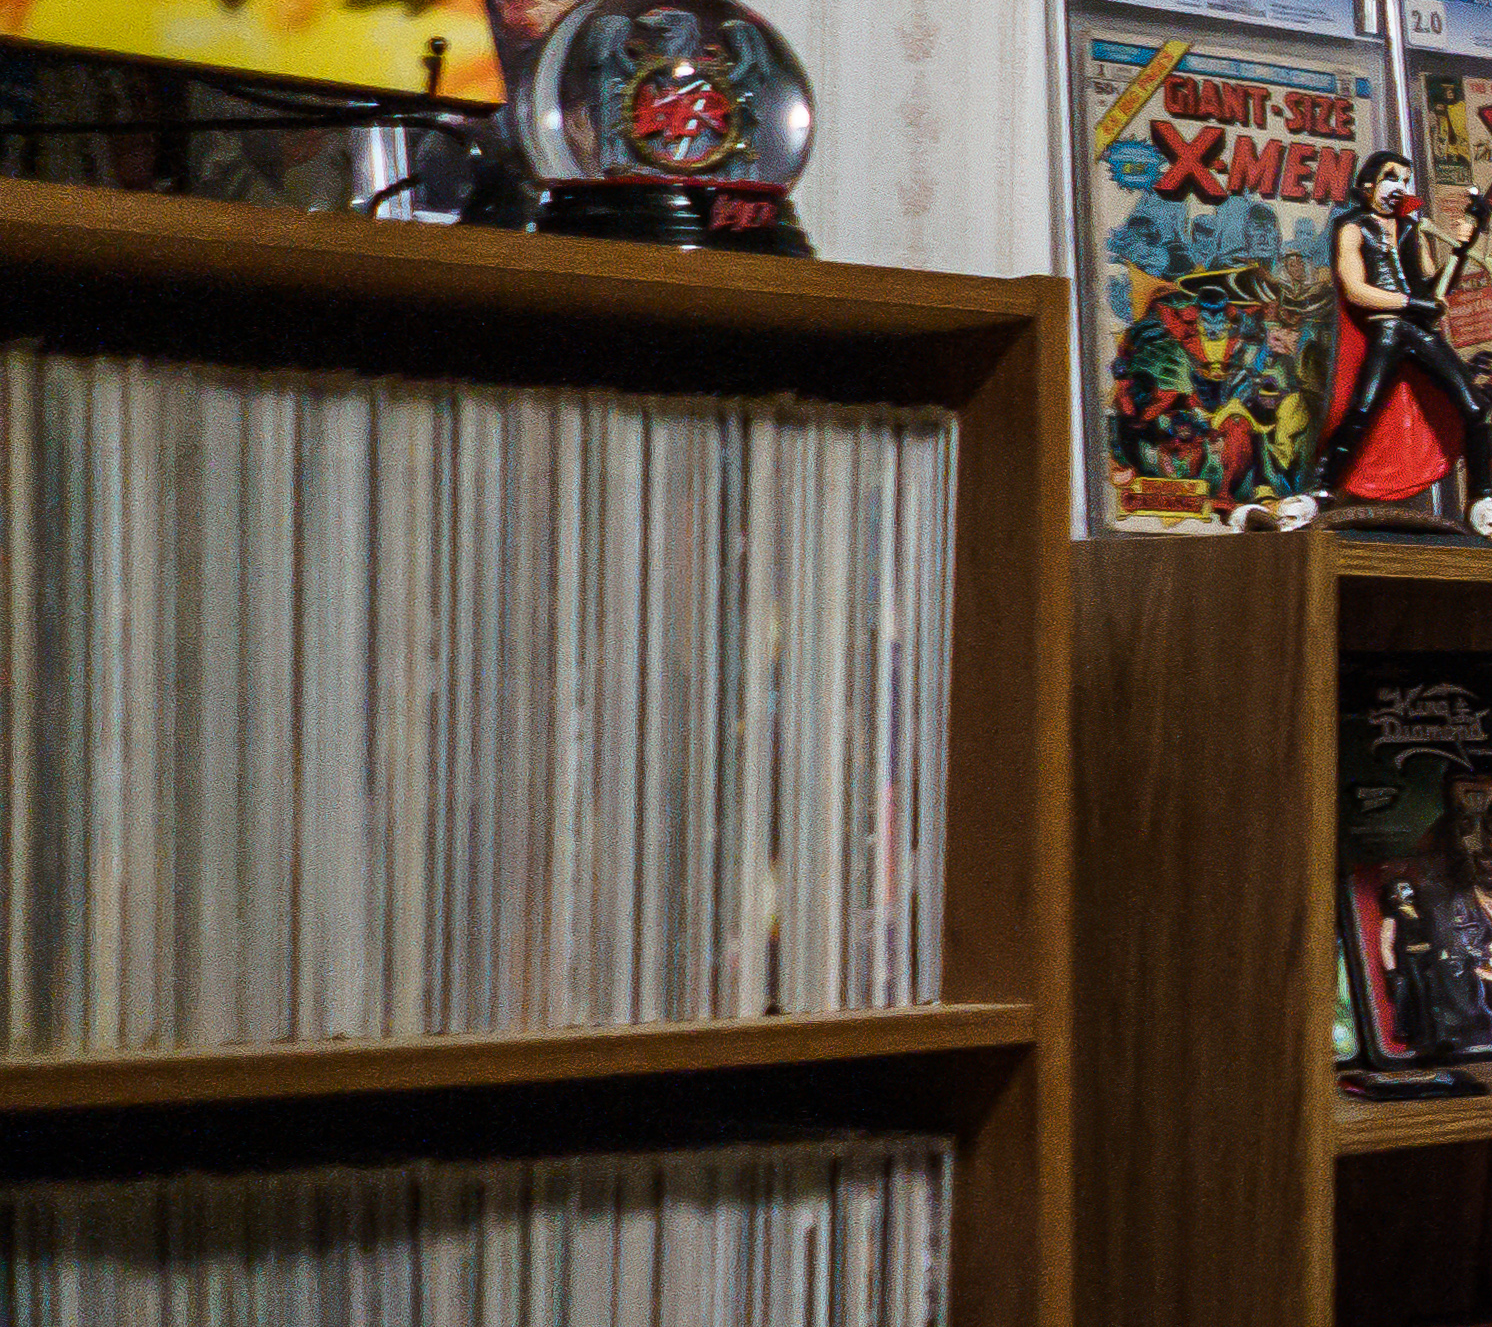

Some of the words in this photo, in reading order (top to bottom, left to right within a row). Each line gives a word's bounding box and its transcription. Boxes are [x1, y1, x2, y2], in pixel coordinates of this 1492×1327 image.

[1411, 9, 1442, 35] 2.0
[1163, 75, 1355, 141] GIANT-SIZE
[1150, 120, 1357, 205] X-MEN
